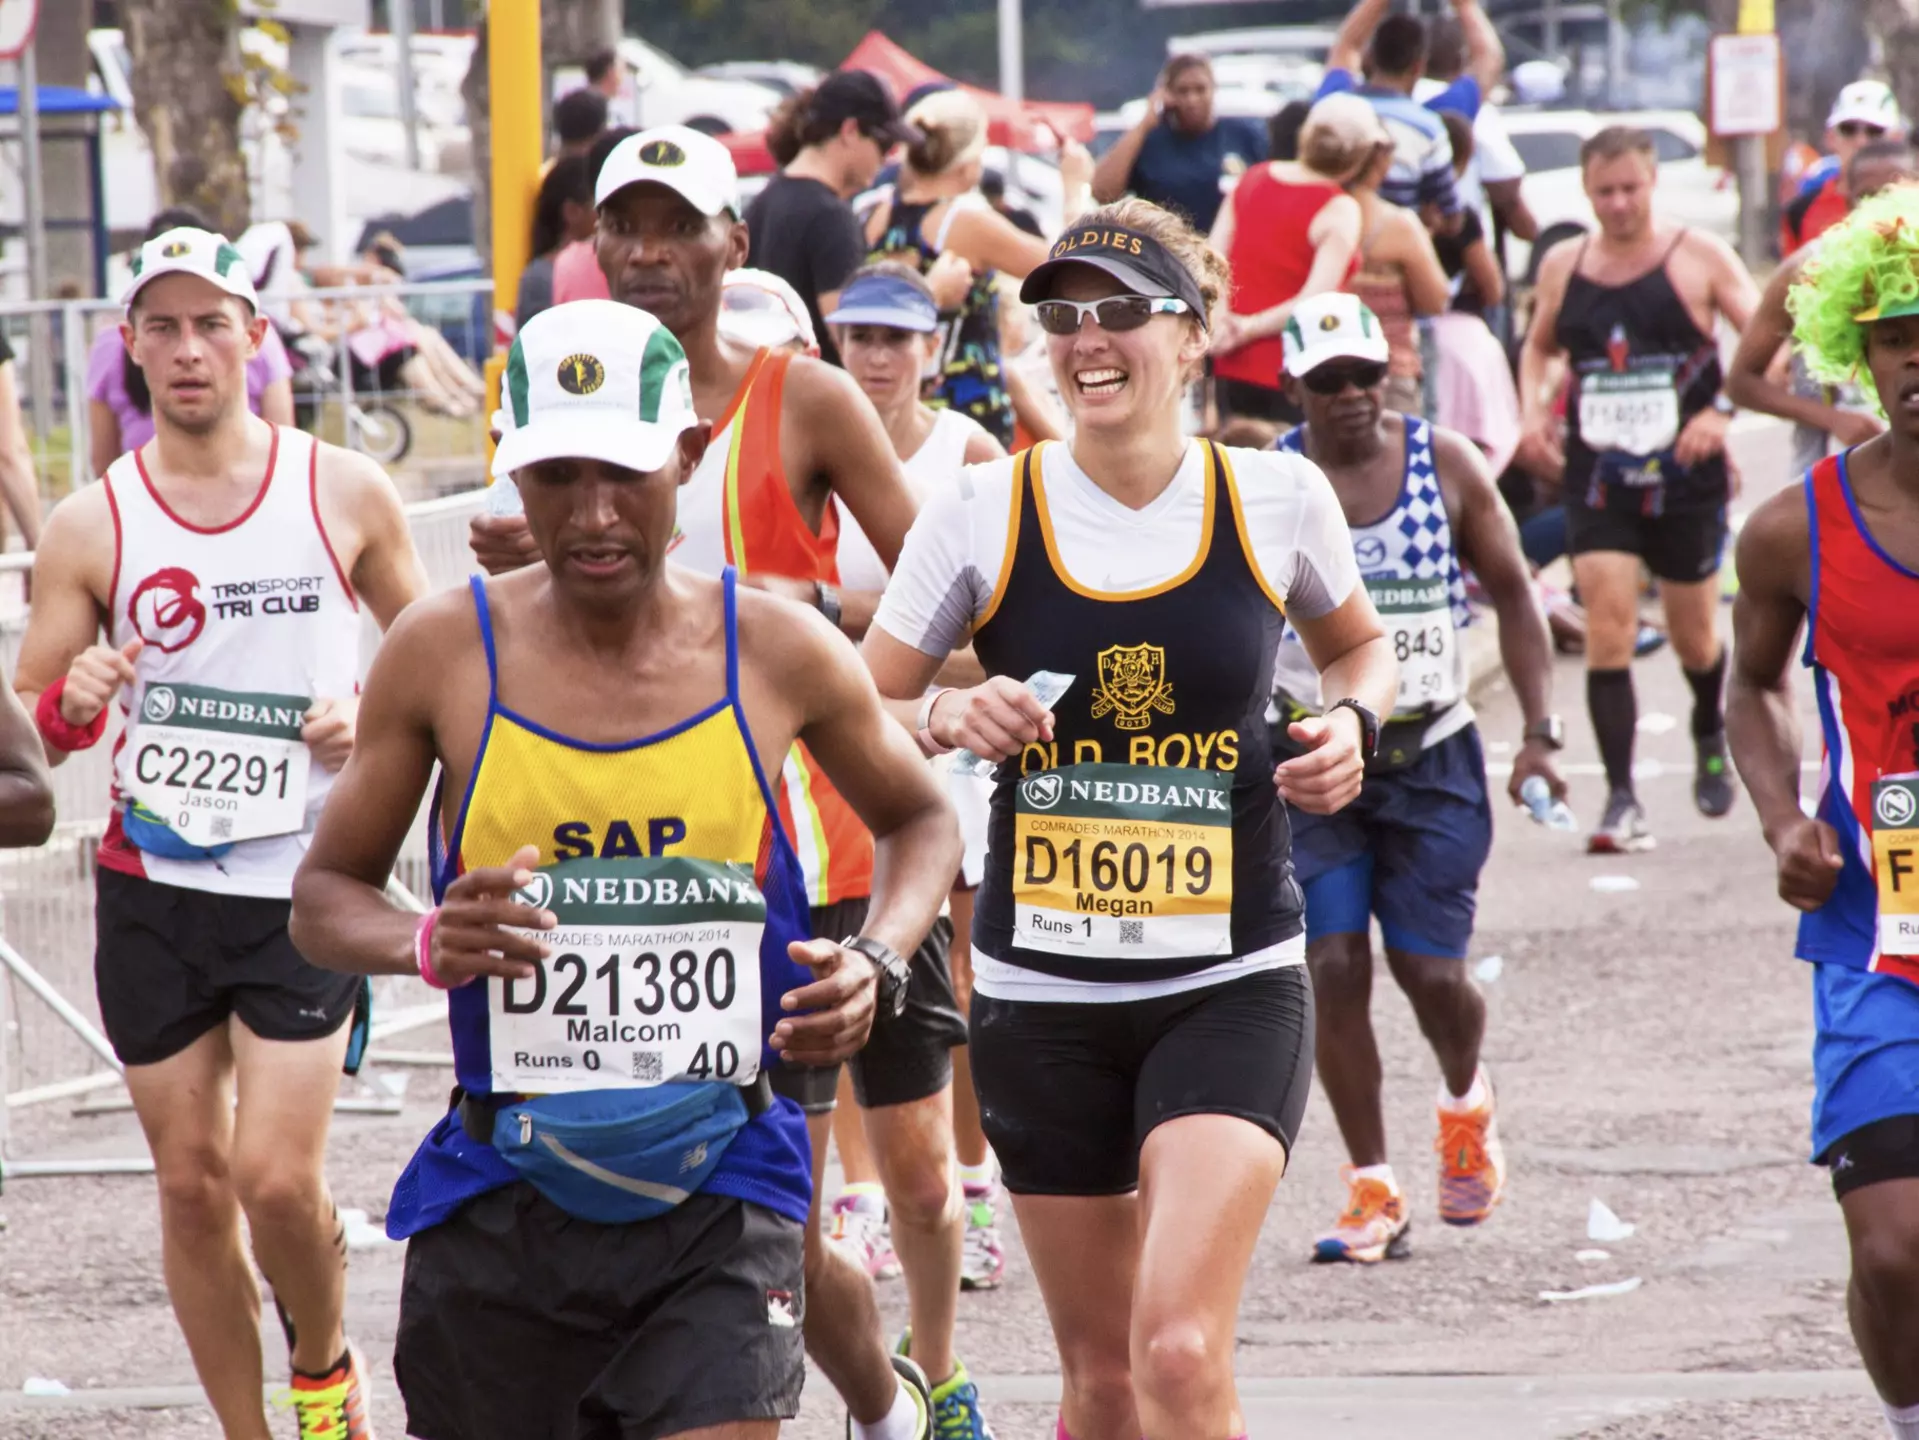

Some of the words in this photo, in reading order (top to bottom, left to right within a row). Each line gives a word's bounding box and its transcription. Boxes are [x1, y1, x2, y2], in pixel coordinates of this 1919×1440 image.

[1054, 230, 1143, 257] OLDIES
[211, 576, 324, 599] TROISPORT
[212, 599, 252, 620] TRI
[262, 595, 319, 614] CLUB
[1130, 729, 1239, 771] BOYS
[136, 743, 290, 800] C22291
[179, 791, 238, 810] Jason
[1070, 780, 1227, 810] NEDBANK
[178, 811, 190, 828] 0
[1031, 820, 1100, 835] COMRADES
[1104, 825, 1175, 839] MARATHON
[1178, 828, 1206, 841] 2014
[553, 816, 687, 861] SAP
[1024, 835, 1213, 896] D16019
[1888, 849, 1913, 892] F
[563, 878, 761, 905] NEDBANK
[1076, 891, 1153, 917] Megan
[608, 931, 694, 945] MARATHON
[698, 929, 731, 942] 2014
[1032, 914, 1073, 934] Runs
[1081, 917, 1092, 937] 1
[502, 947, 736, 1016] D21380
[567, 1018, 681, 1043] Malcom
[514, 1051, 573, 1068] Runs
[583, 1050, 600, 1071] 0
[686, 1041, 739, 1080] 40
